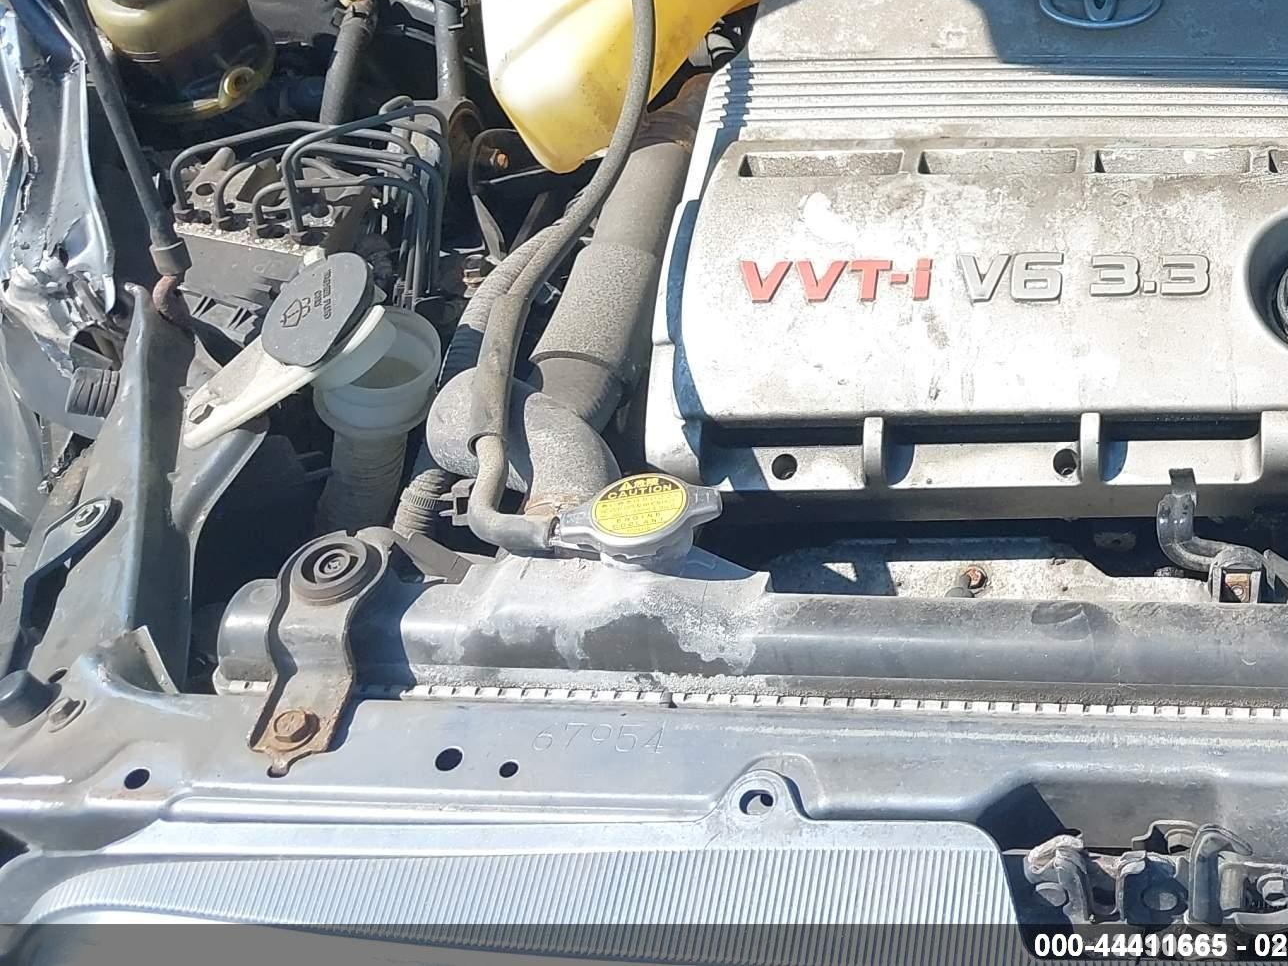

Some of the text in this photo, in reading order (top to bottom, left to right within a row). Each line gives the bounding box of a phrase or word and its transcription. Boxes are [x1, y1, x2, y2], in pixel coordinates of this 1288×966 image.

[738, 251, 1212, 305] VVT-i V6 3.3
[607, 483, 672, 500] CAUTION
